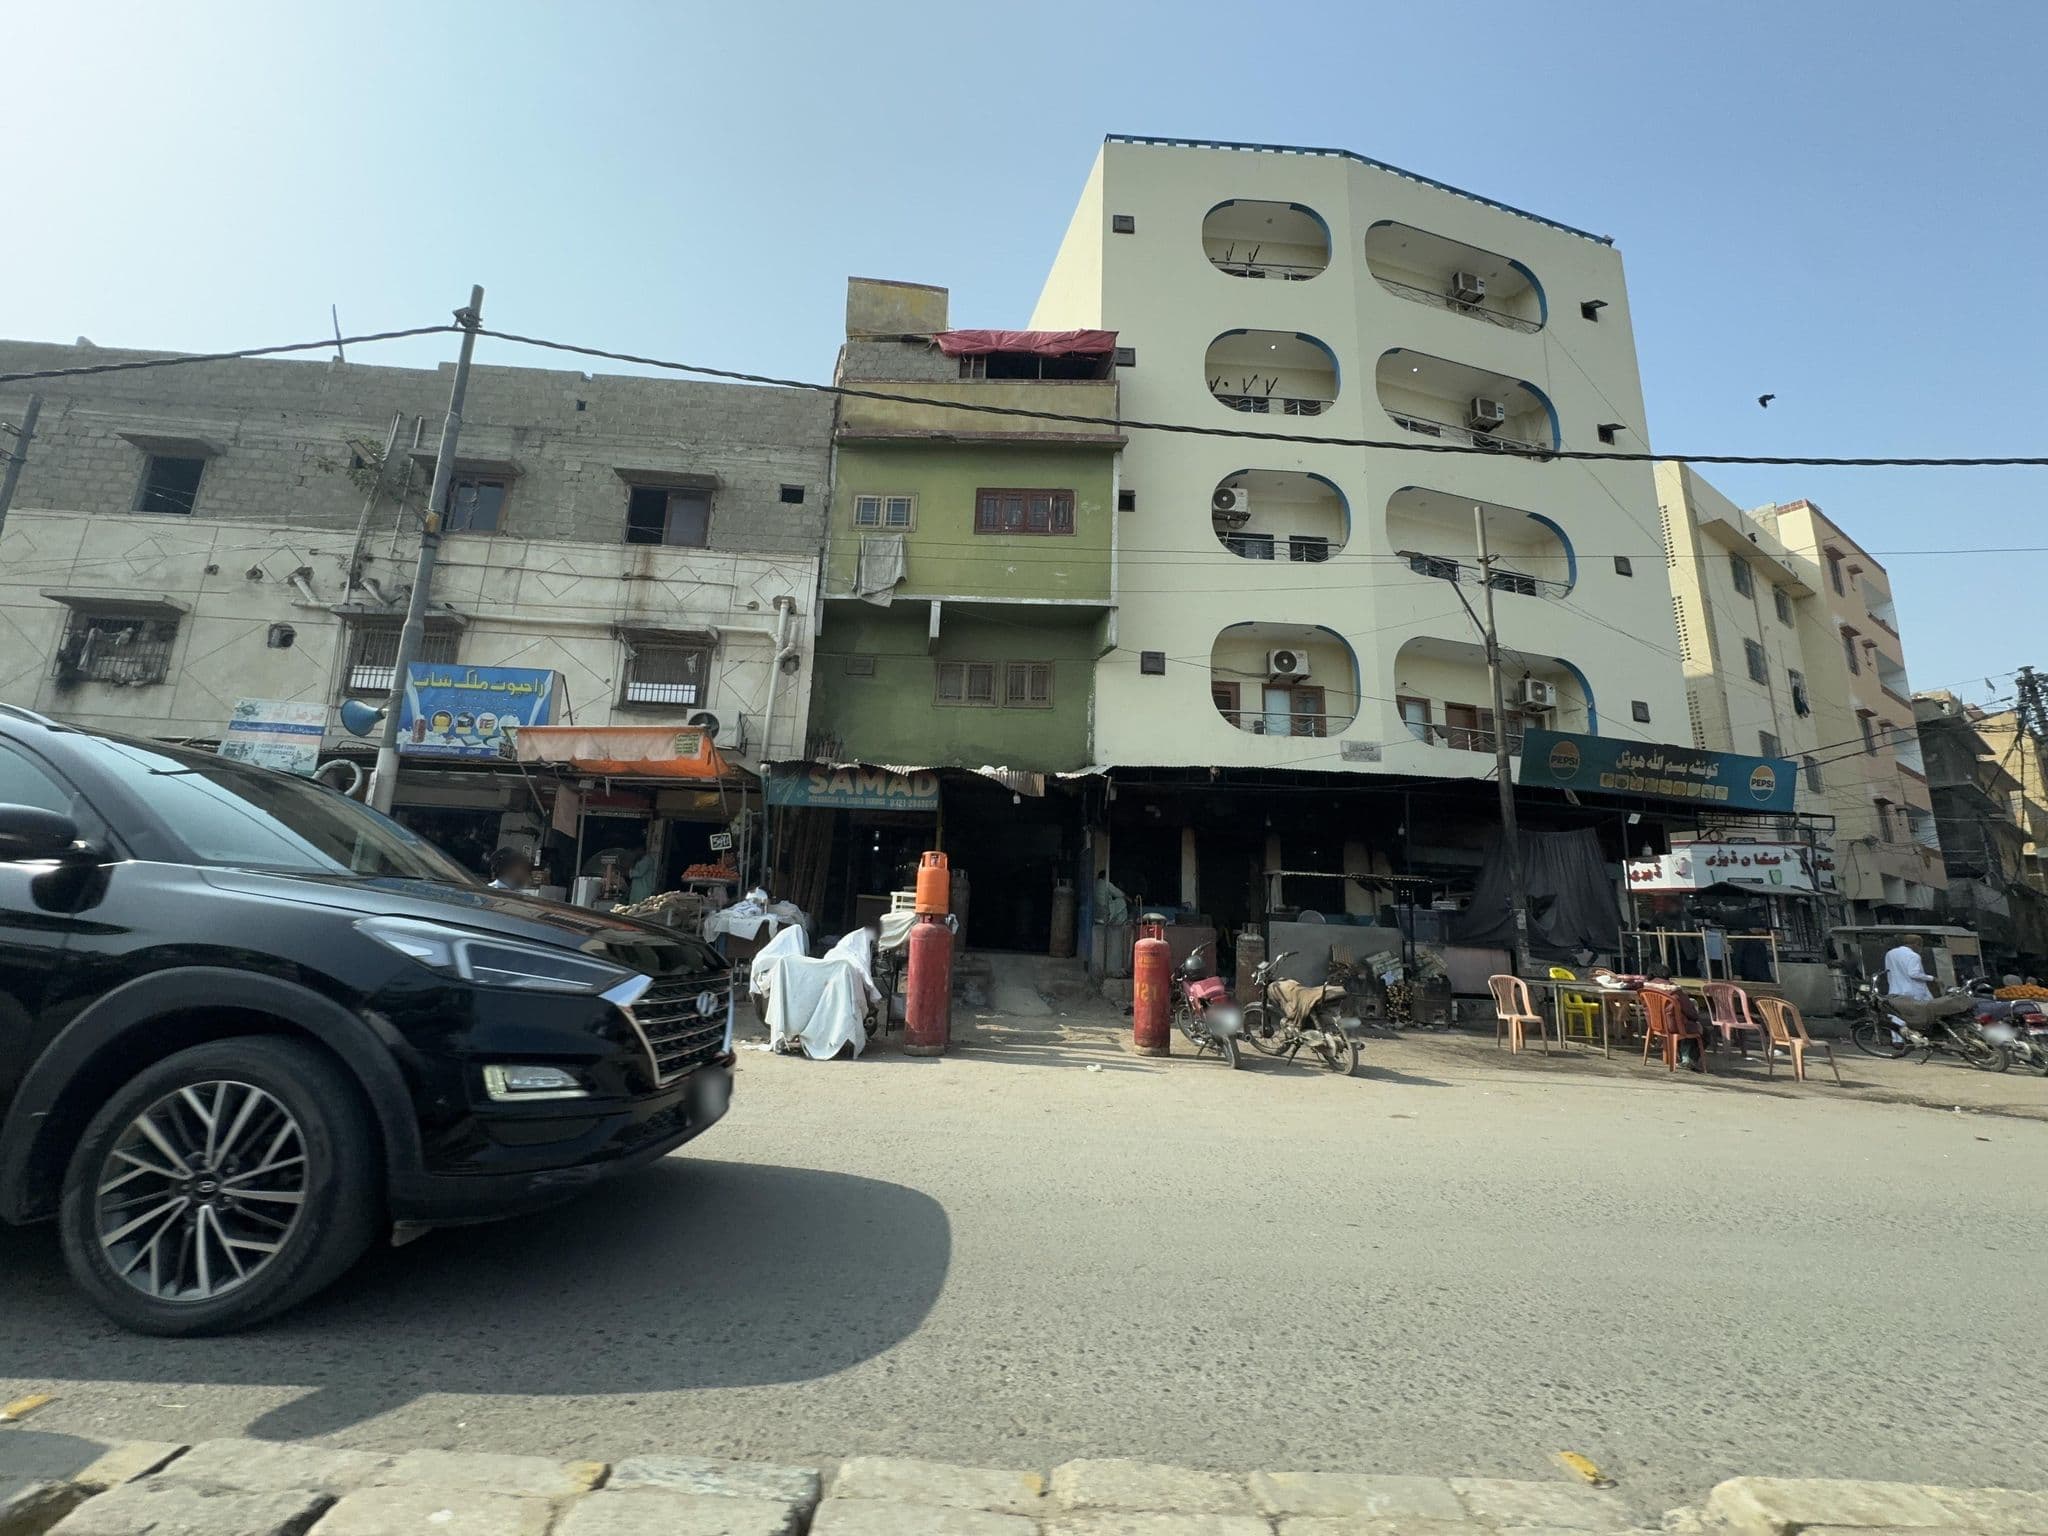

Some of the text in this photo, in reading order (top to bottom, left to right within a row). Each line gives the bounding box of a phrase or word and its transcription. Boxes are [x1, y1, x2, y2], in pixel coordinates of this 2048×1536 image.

[413, 671, 452, 688] شاپ
[454, 670, 489, 690] ملک
[1550, 754, 1579, 769] PEPSI
[1664, 759, 1688, 777] بسم
[807, 766, 938, 798] SAMAD
[1751, 777, 1775, 789] PEPSI
